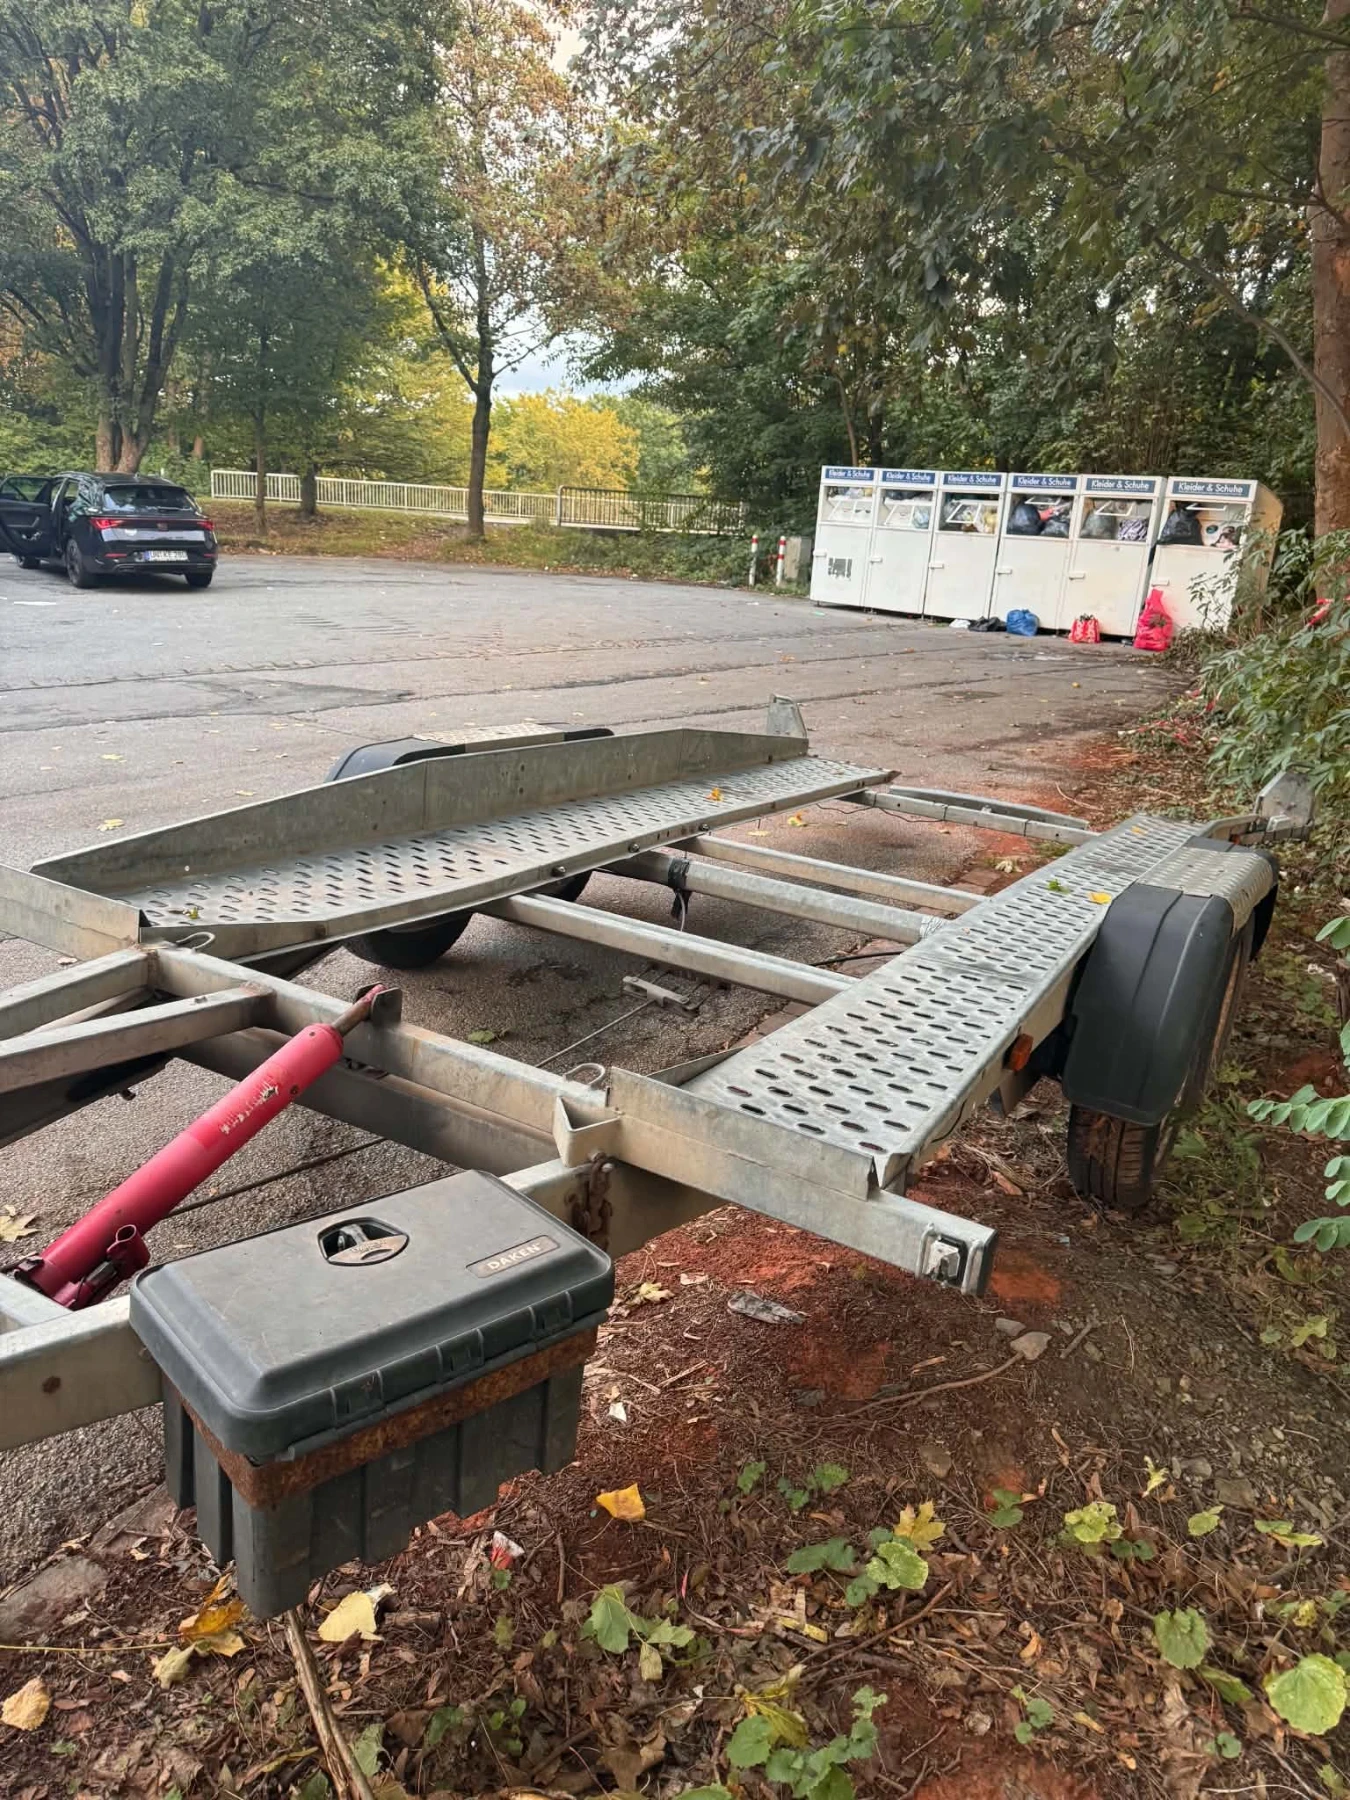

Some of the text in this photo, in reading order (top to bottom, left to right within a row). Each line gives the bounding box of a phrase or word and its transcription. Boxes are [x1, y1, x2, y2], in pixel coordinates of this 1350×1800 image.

[948, 474, 969, 482] Kleider
[975, 475, 997, 483] Schuhe
[1017, 477, 1040, 485] Kleider
[1048, 477, 1072, 486] Schuhe
[1091, 479, 1115, 488] Kleider
[1124, 480, 1149, 489] Schuhe
[1178, 482, 1205, 491] Kleider
[1216, 483, 1243, 493] Schuhe
[487, 1243, 541, 1270] DAKEN
